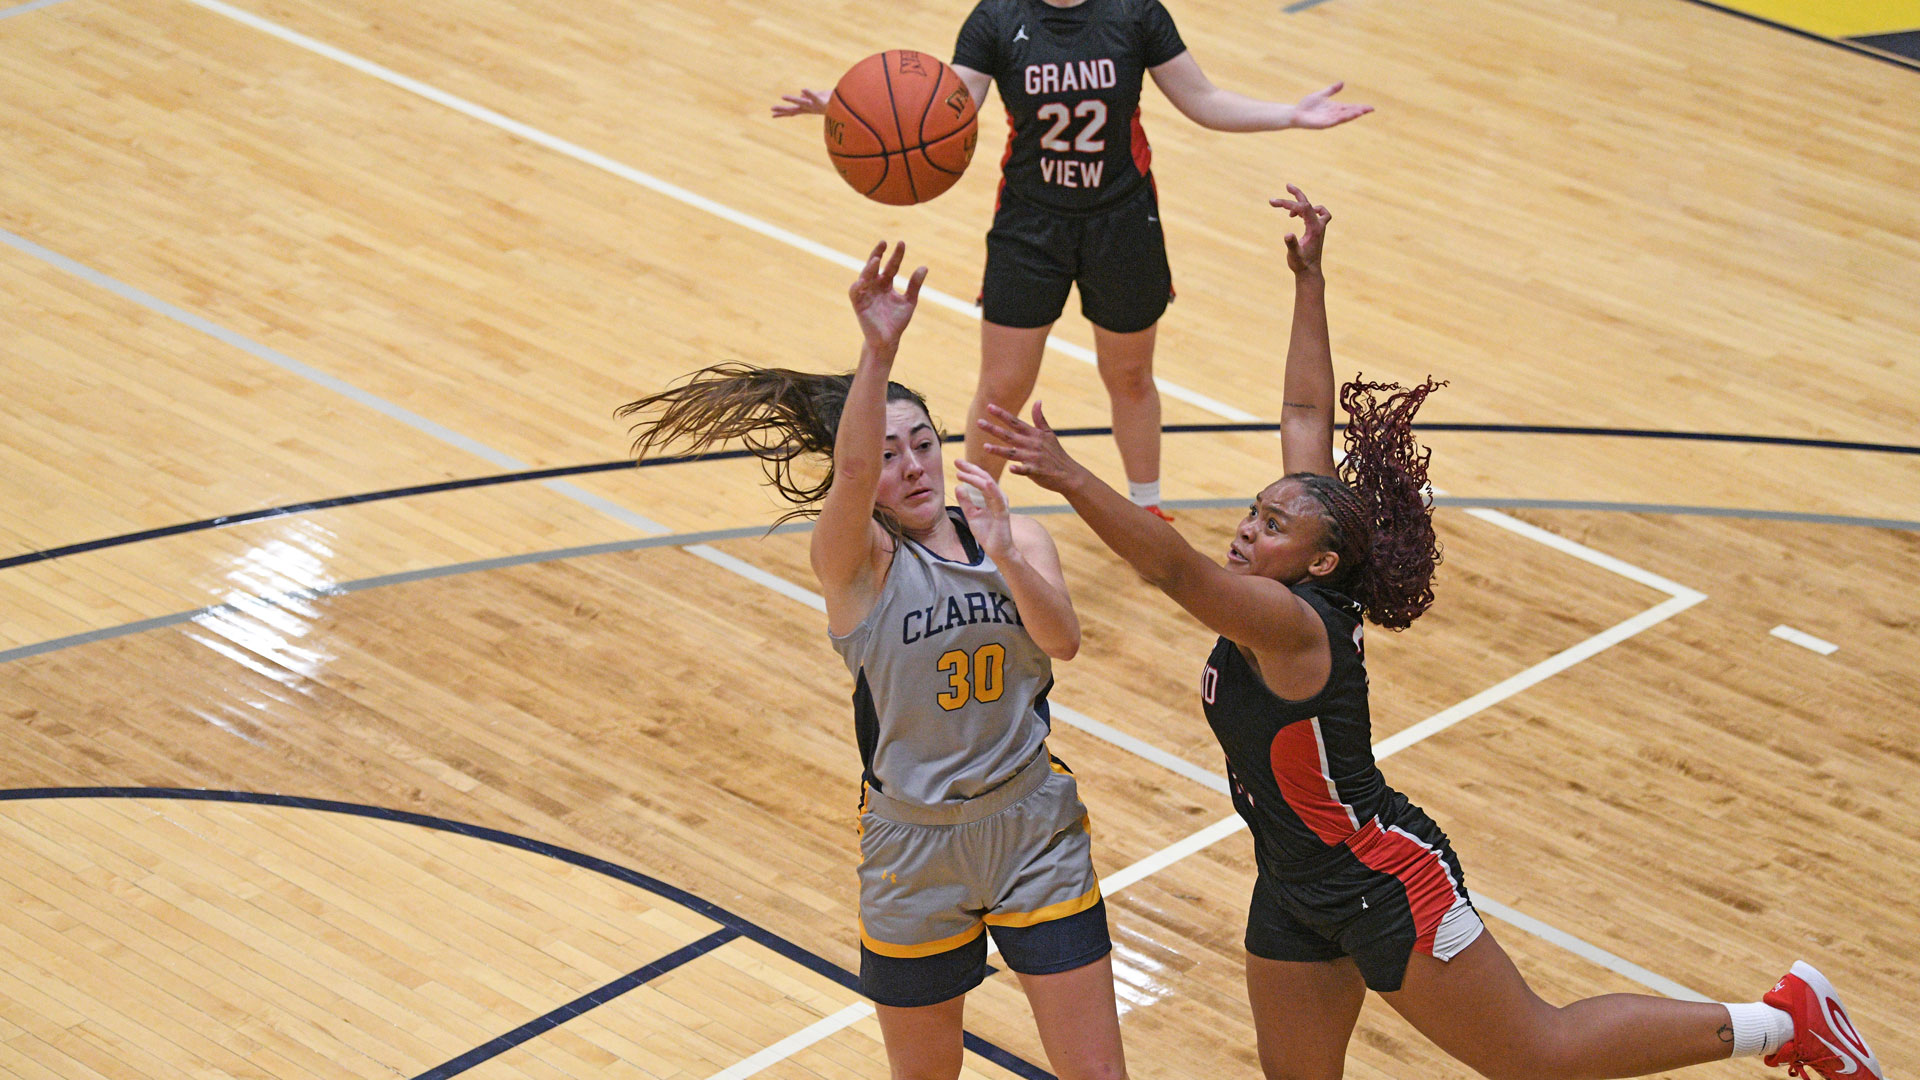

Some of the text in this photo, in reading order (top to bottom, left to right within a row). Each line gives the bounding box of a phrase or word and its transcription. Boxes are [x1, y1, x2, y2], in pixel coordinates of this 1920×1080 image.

[1024, 58, 1117, 95] GRAND
[1037, 99, 1107, 153] 22
[1040, 156, 1104, 188] VIEW
[936, 642, 1006, 711] 30
